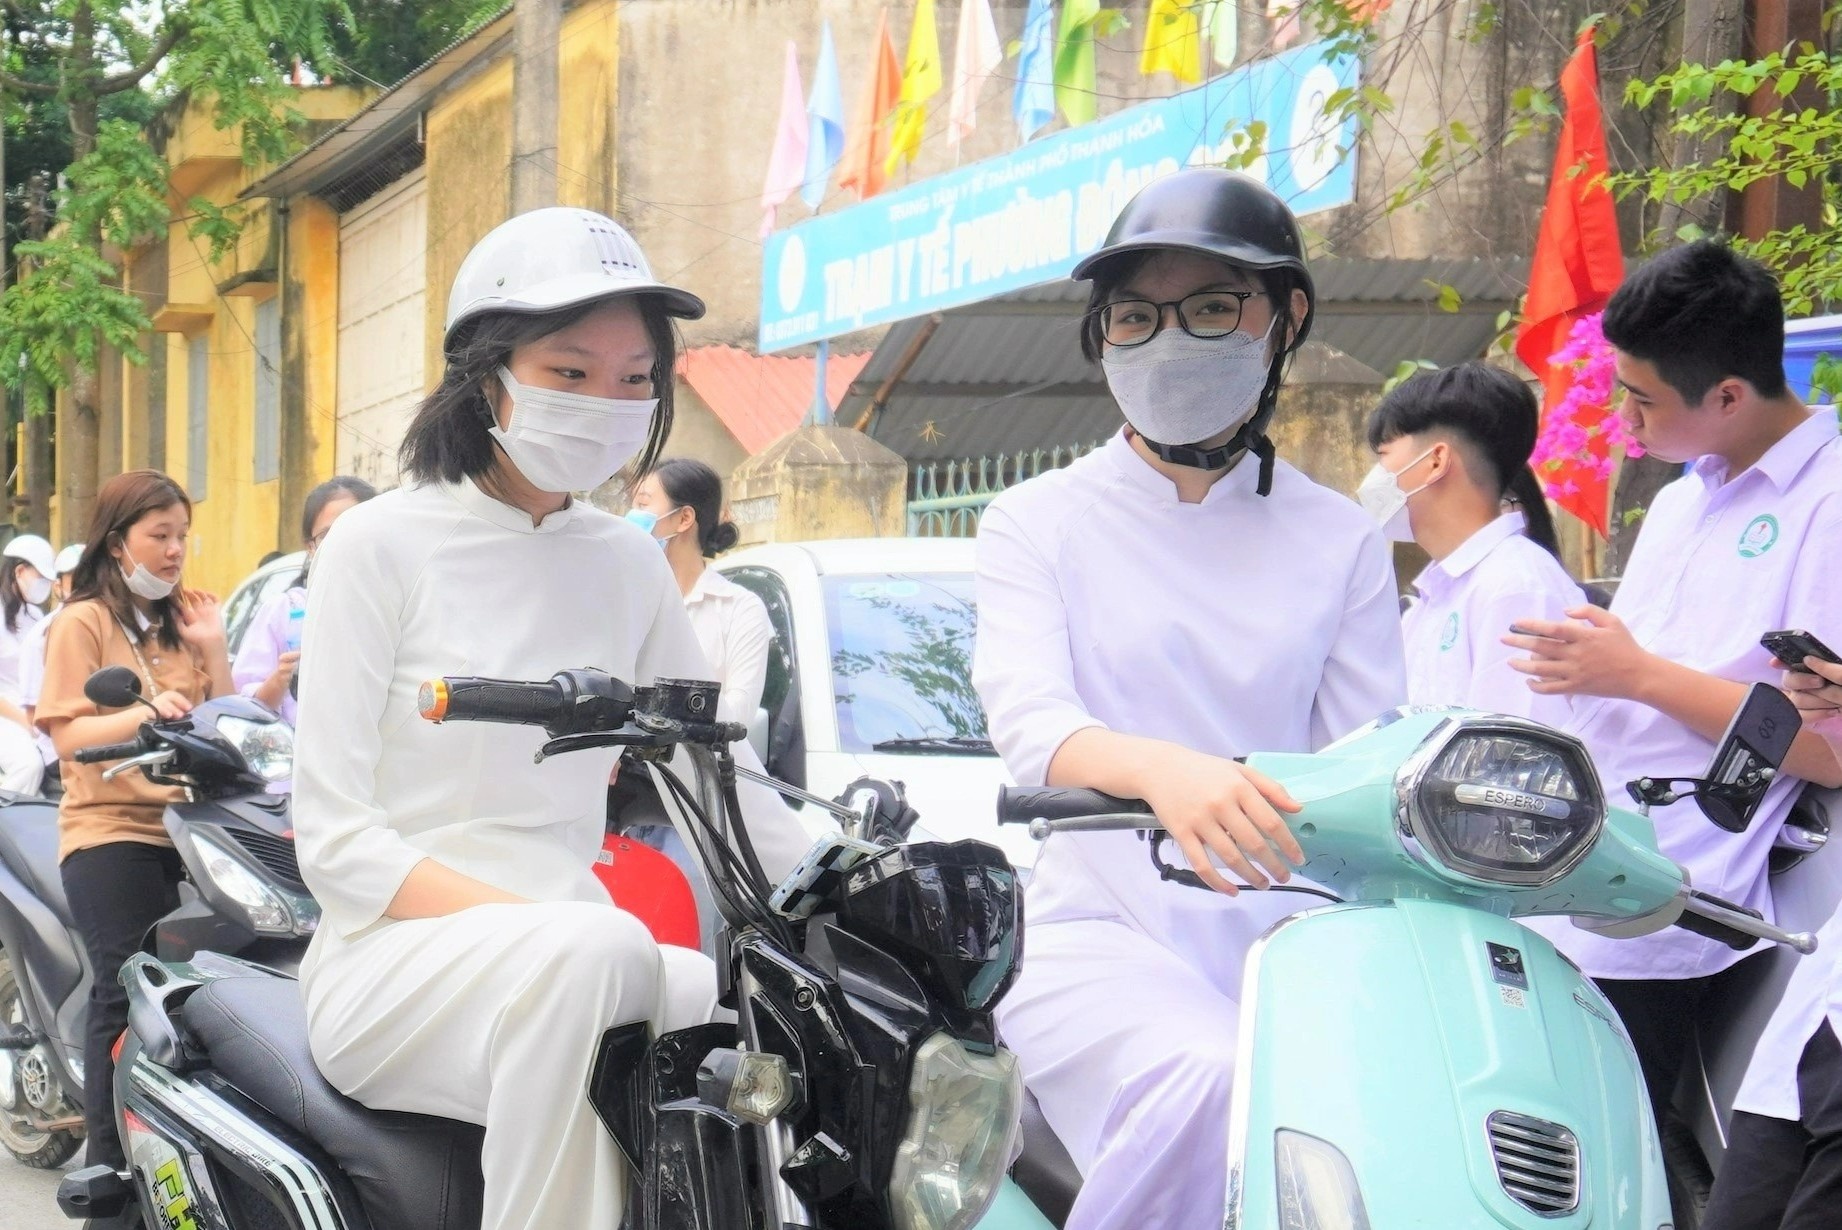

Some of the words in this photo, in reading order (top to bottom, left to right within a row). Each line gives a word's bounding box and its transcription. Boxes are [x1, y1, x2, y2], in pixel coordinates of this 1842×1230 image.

[888, 196, 930, 223] TRUNG
[931, 184, 959, 209] TÂM
[985, 160, 1036, 188] THÀNH
[1038, 140, 1068, 173] PHỐ
[1068, 128, 1125, 162] THANH
[1127, 113, 1166, 144] HÓA
[824, 244, 895, 328] TRẠM
[896, 237, 917, 303] Y
[917, 203, 951, 299] TẾ
[951, 184, 1074, 290] PHƯỜNG
[1075, 157, 1180, 256] ĐÔ
[1484, 789, 1547, 813] ESPERO
[213, 1125, 254, 1154] ELECTRIC
